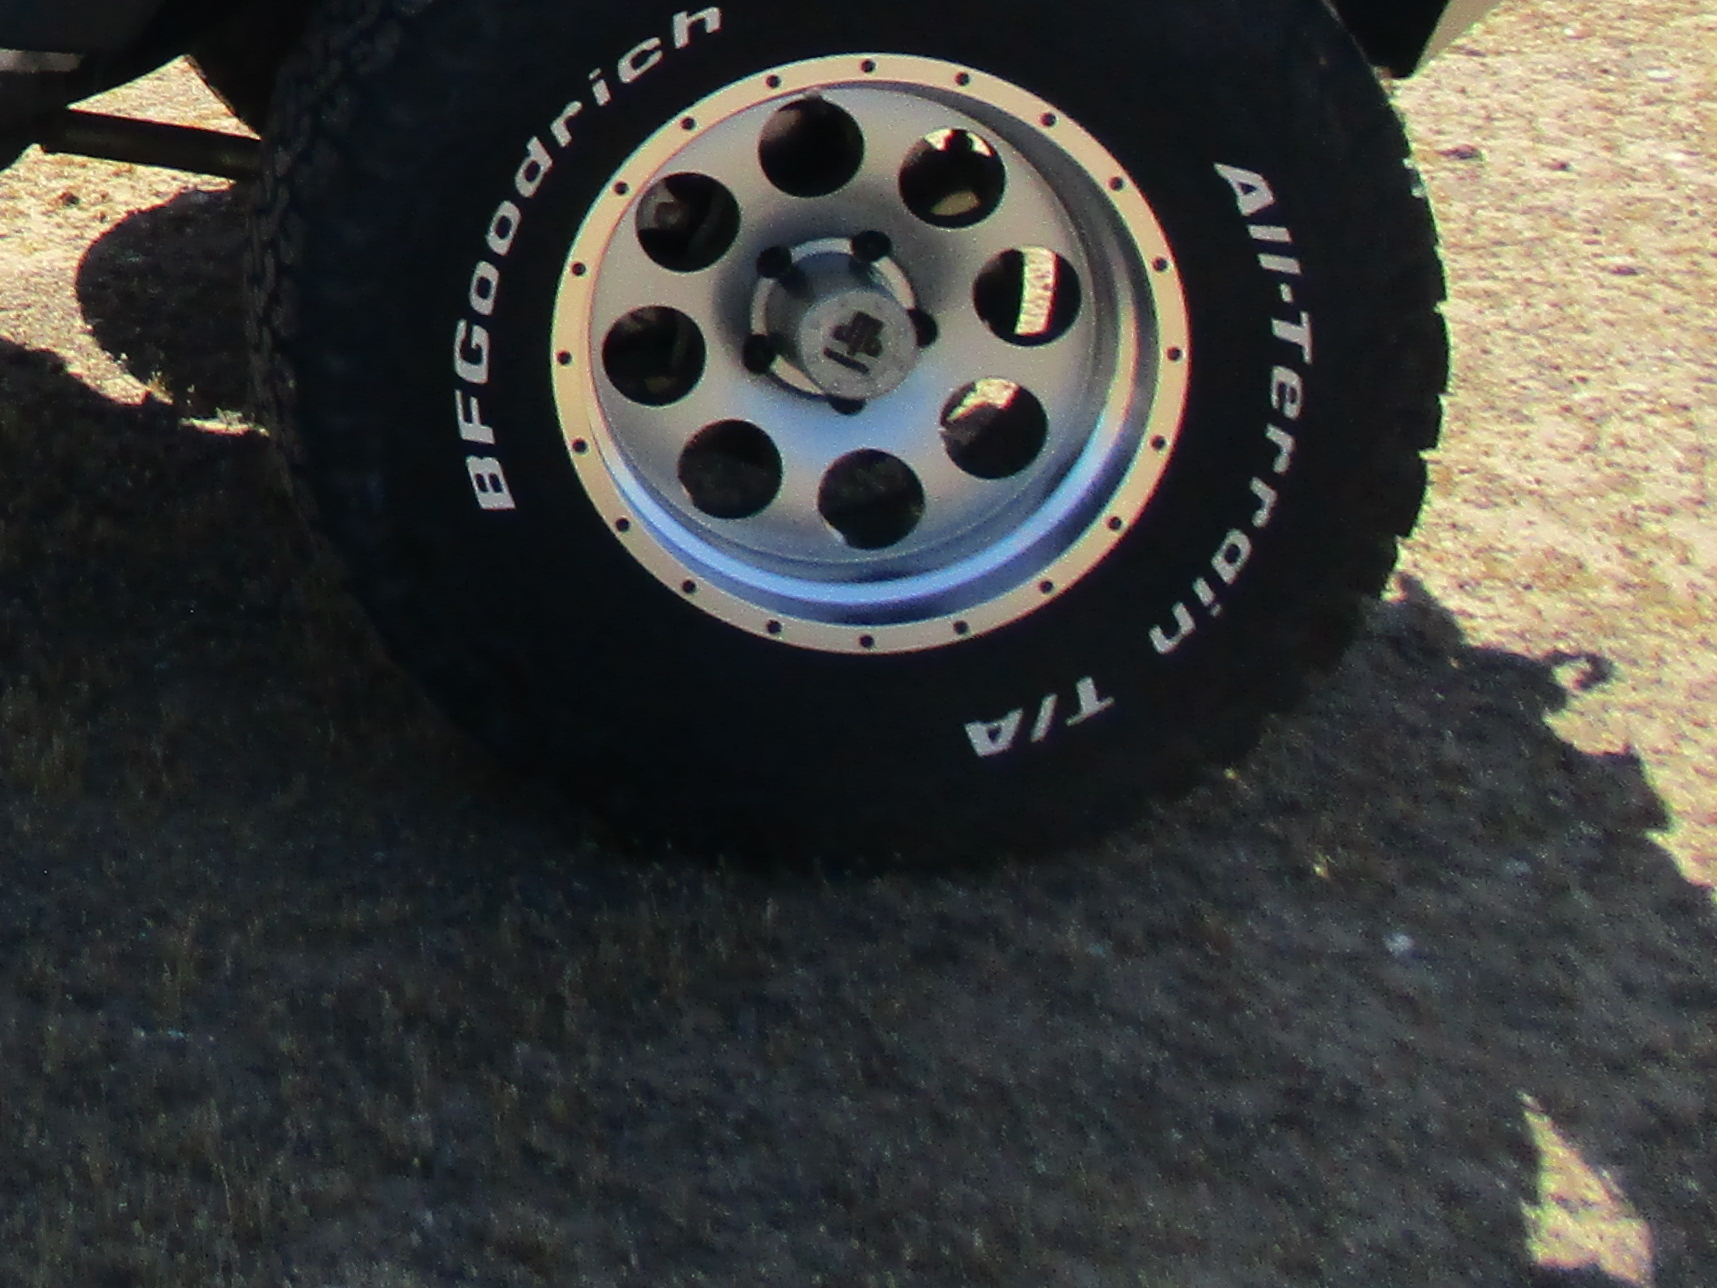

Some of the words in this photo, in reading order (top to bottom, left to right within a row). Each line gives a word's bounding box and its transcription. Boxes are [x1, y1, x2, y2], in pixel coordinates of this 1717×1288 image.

[452, 5, 723, 511] BFGoodrich
[1148, 162, 1313, 655] All-Terrain
[964, 676, 1114, 757] T/A
